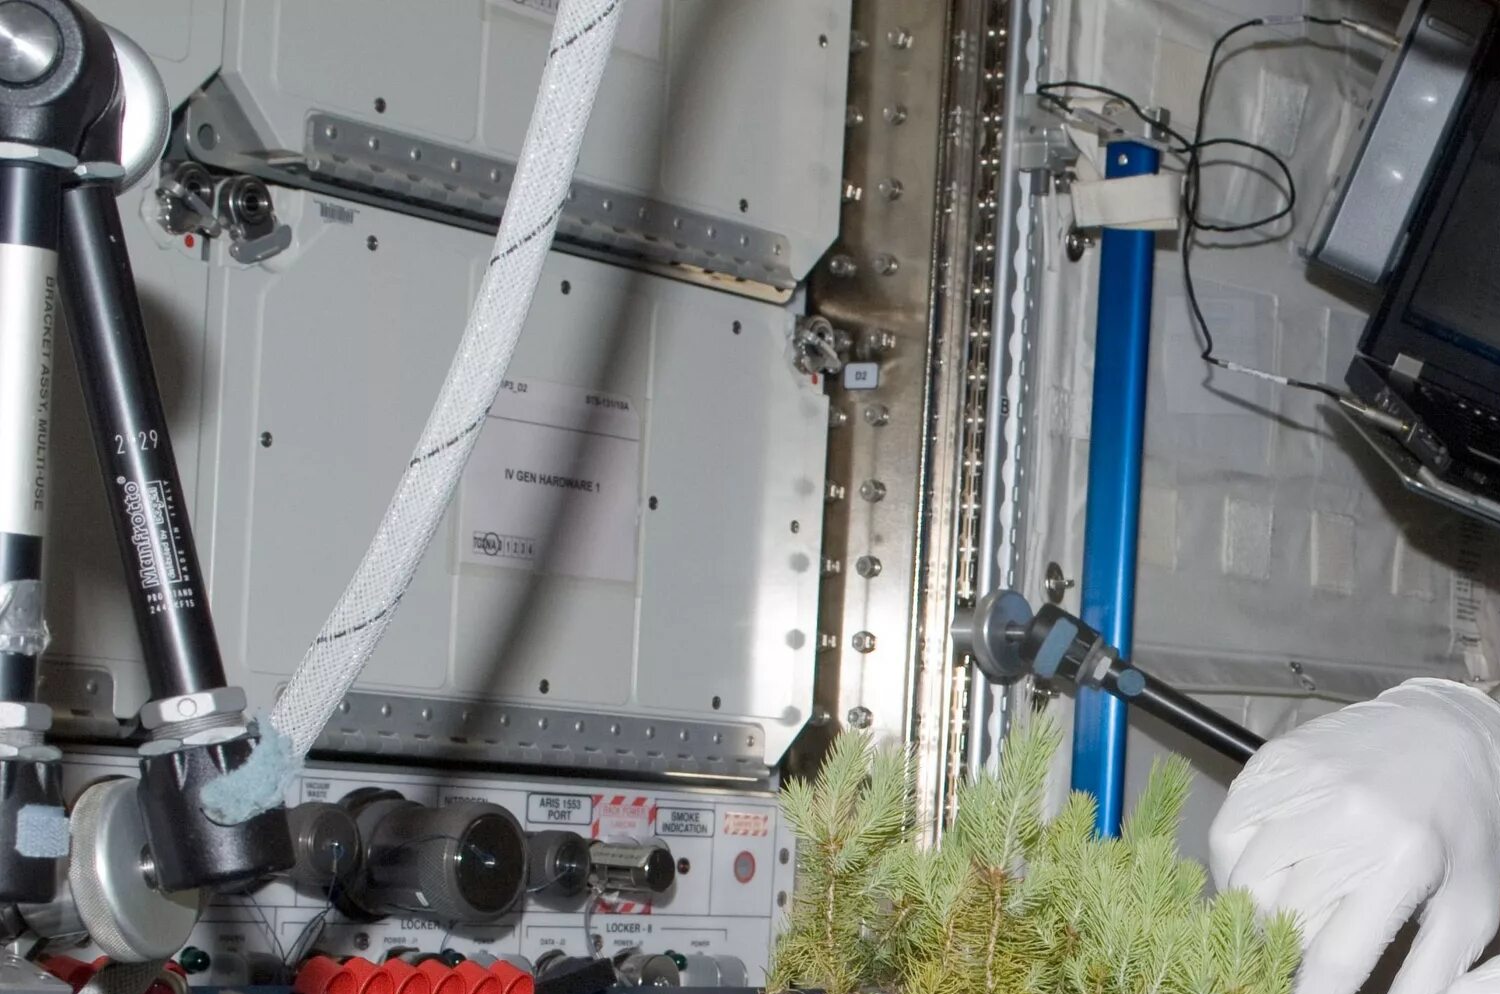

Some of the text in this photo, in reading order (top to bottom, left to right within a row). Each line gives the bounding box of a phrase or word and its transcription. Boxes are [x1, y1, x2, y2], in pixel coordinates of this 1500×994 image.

[854, 370, 868, 382] D2
[33, 275, 54, 512] BRACKET ASSY, MULTI-USE
[504, 467, 515, 481] IV
[516, 469, 537, 484] GEN
[538, 473, 593, 493] HARDWARE
[162, 479, 177, 518] ITALY
[124, 480, 161, 590] Manfrotto
[177, 549, 190, 583] MADE
[539, 797, 582, 811] ARIS 1553
[547, 809, 572, 821] PORT
[671, 811, 701, 823] SMOKE
[662, 822, 708, 834] INDICATION
[401, 919, 441, 930] LOCKER
[605, 922, 641, 933] LOCKER
[539, 937, 556, 946] DATA
